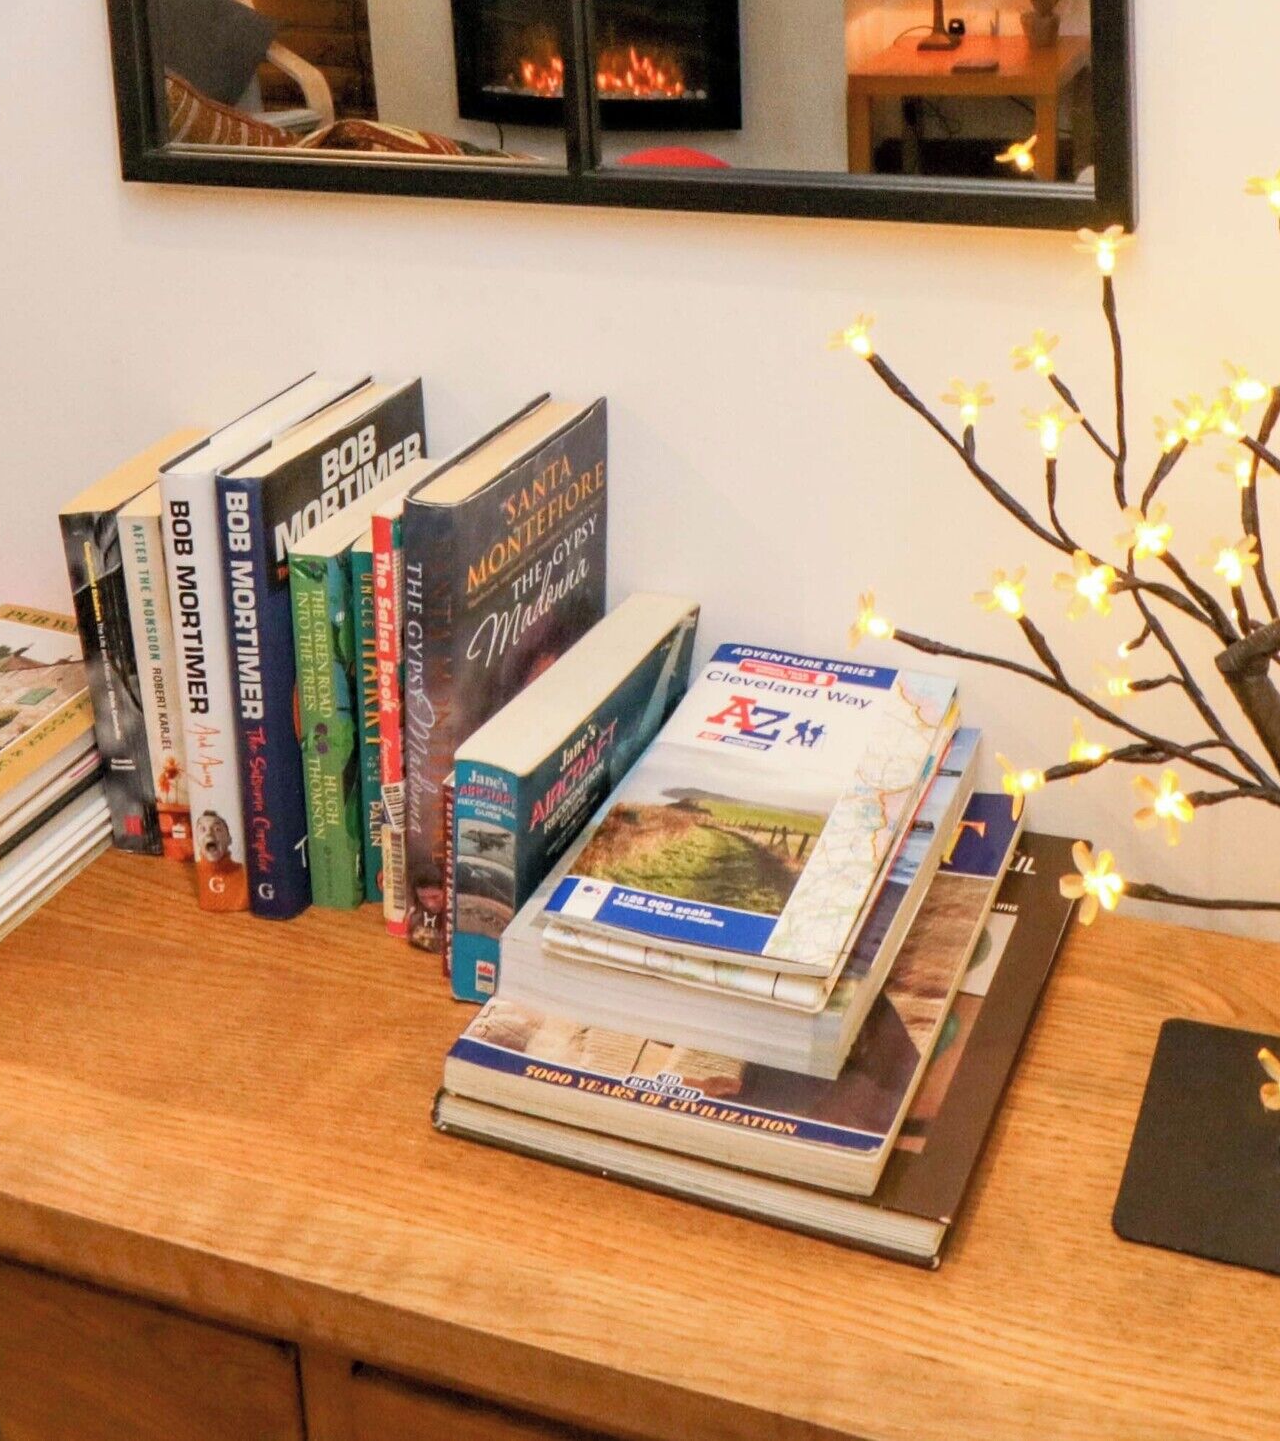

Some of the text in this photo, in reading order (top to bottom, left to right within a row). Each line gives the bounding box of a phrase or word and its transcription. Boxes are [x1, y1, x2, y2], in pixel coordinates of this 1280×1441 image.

[321, 425, 376, 489] BOB
[502, 454, 572, 525] SANTA
[274, 432, 420, 562] MORTIMER
[466, 461, 605, 595] MONTEFIORE
[132, 525, 161, 660] AFTER THE MONSOON
[407, 562, 422, 615] THE
[512, 513, 598, 601] THE GYPSY
[170, 500, 210, 714] BOB MORTIMER
[225, 491, 265, 720] BOB MORTIMER
[360, 573, 375, 628] UNCLE
[376, 552, 398, 714] The Salsa Book
[466, 558, 590, 668] Madonna
[297, 592, 317, 711] INTO THE TREES
[312, 590, 333, 718] THE GREEN ROAD
[407, 621, 424, 705] GYPSY
[731, 646, 824, 670] ADVENTURE
[825, 660, 878, 678] SERIES
[152, 667, 166, 708] ROBERT
[706, 670, 820, 699] Cleveland
[826, 689, 873, 710] Way
[468, 770, 508, 792] Jane's
[529, 717, 619, 834] AIRCRAFT
[559, 724, 598, 772] Jane's
[308, 759, 325, 840] THOMSON
[324, 774, 339, 825] HUGH
[369, 801, 383, 847] PALIN
[208, 876, 225, 893] G
[258, 882, 275, 900] G
[617, 892, 713, 920] 1:25 000 scale
[524, 1064, 572, 1085] 5000
[577, 1077, 636, 1101] YEARS
[639, 1092, 664, 1108] OF
[669, 1100, 798, 1135] CIVILIZATION
